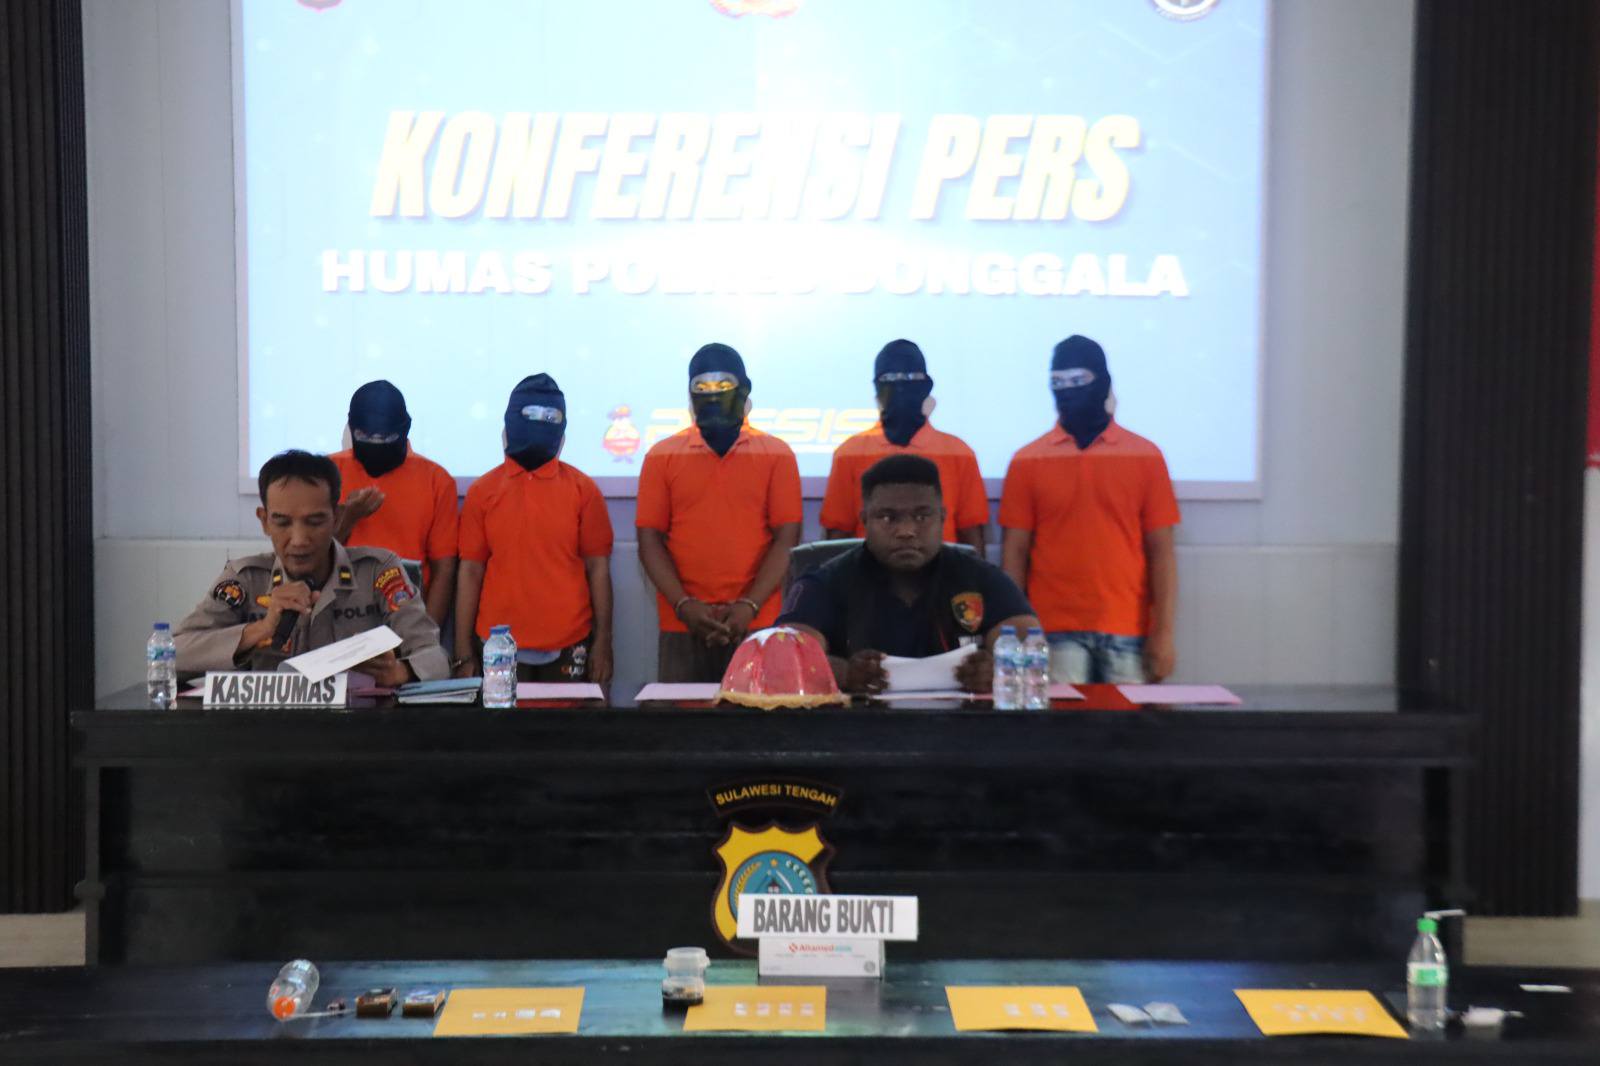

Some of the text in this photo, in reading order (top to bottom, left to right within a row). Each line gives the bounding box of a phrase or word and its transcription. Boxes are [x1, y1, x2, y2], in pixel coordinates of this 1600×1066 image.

[370, 110, 1141, 223] KONFERENSI PERS
[321, 249, 552, 294] HUMAS
[839, 252, 1189, 297] ONGGALA
[210, 674, 336, 704] KASIHUMAS
[715, 784, 838, 806] SULAWESI TENGAH
[753, 898, 894, 933] BARANG BUKTI
